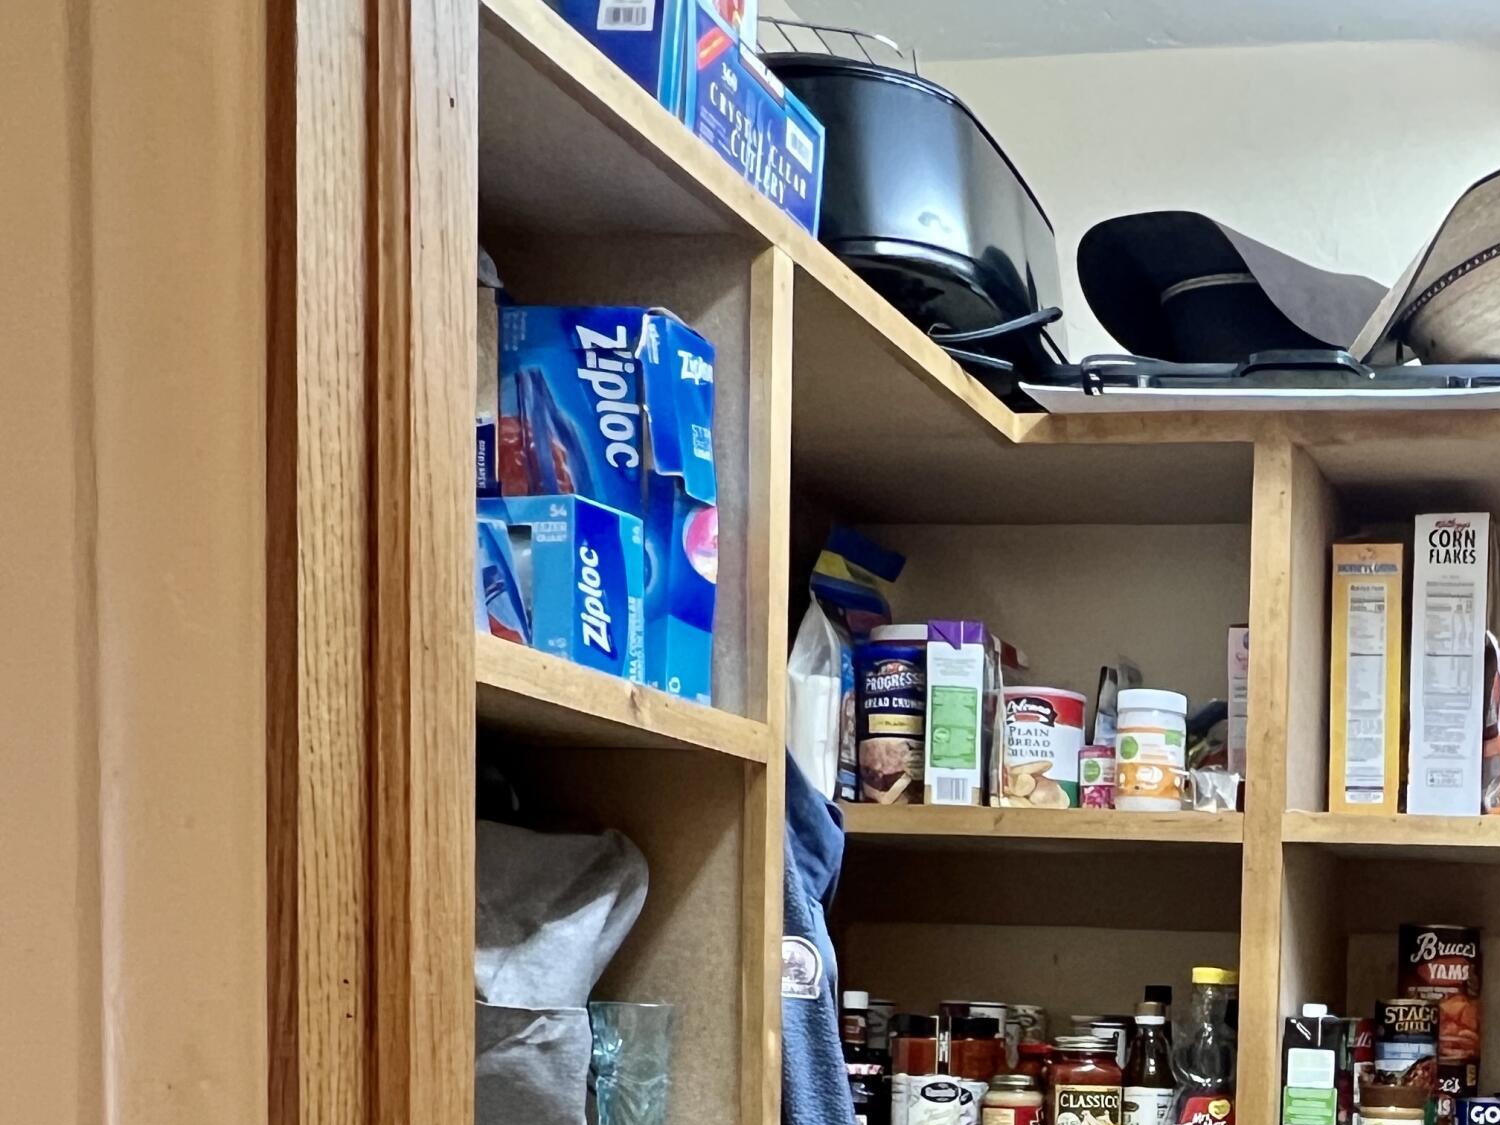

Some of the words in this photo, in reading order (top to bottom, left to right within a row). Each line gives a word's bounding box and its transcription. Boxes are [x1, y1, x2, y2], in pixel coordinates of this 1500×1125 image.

[575, 324, 640, 469] Ziploc
[1428, 529, 1476, 550] CORN
[1429, 549, 1476, 564] FLAKES
[577, 545, 612, 654] Ziploc
[1008, 726, 1050, 737] PLAIN
[1428, 963, 1469, 980] YAMS
